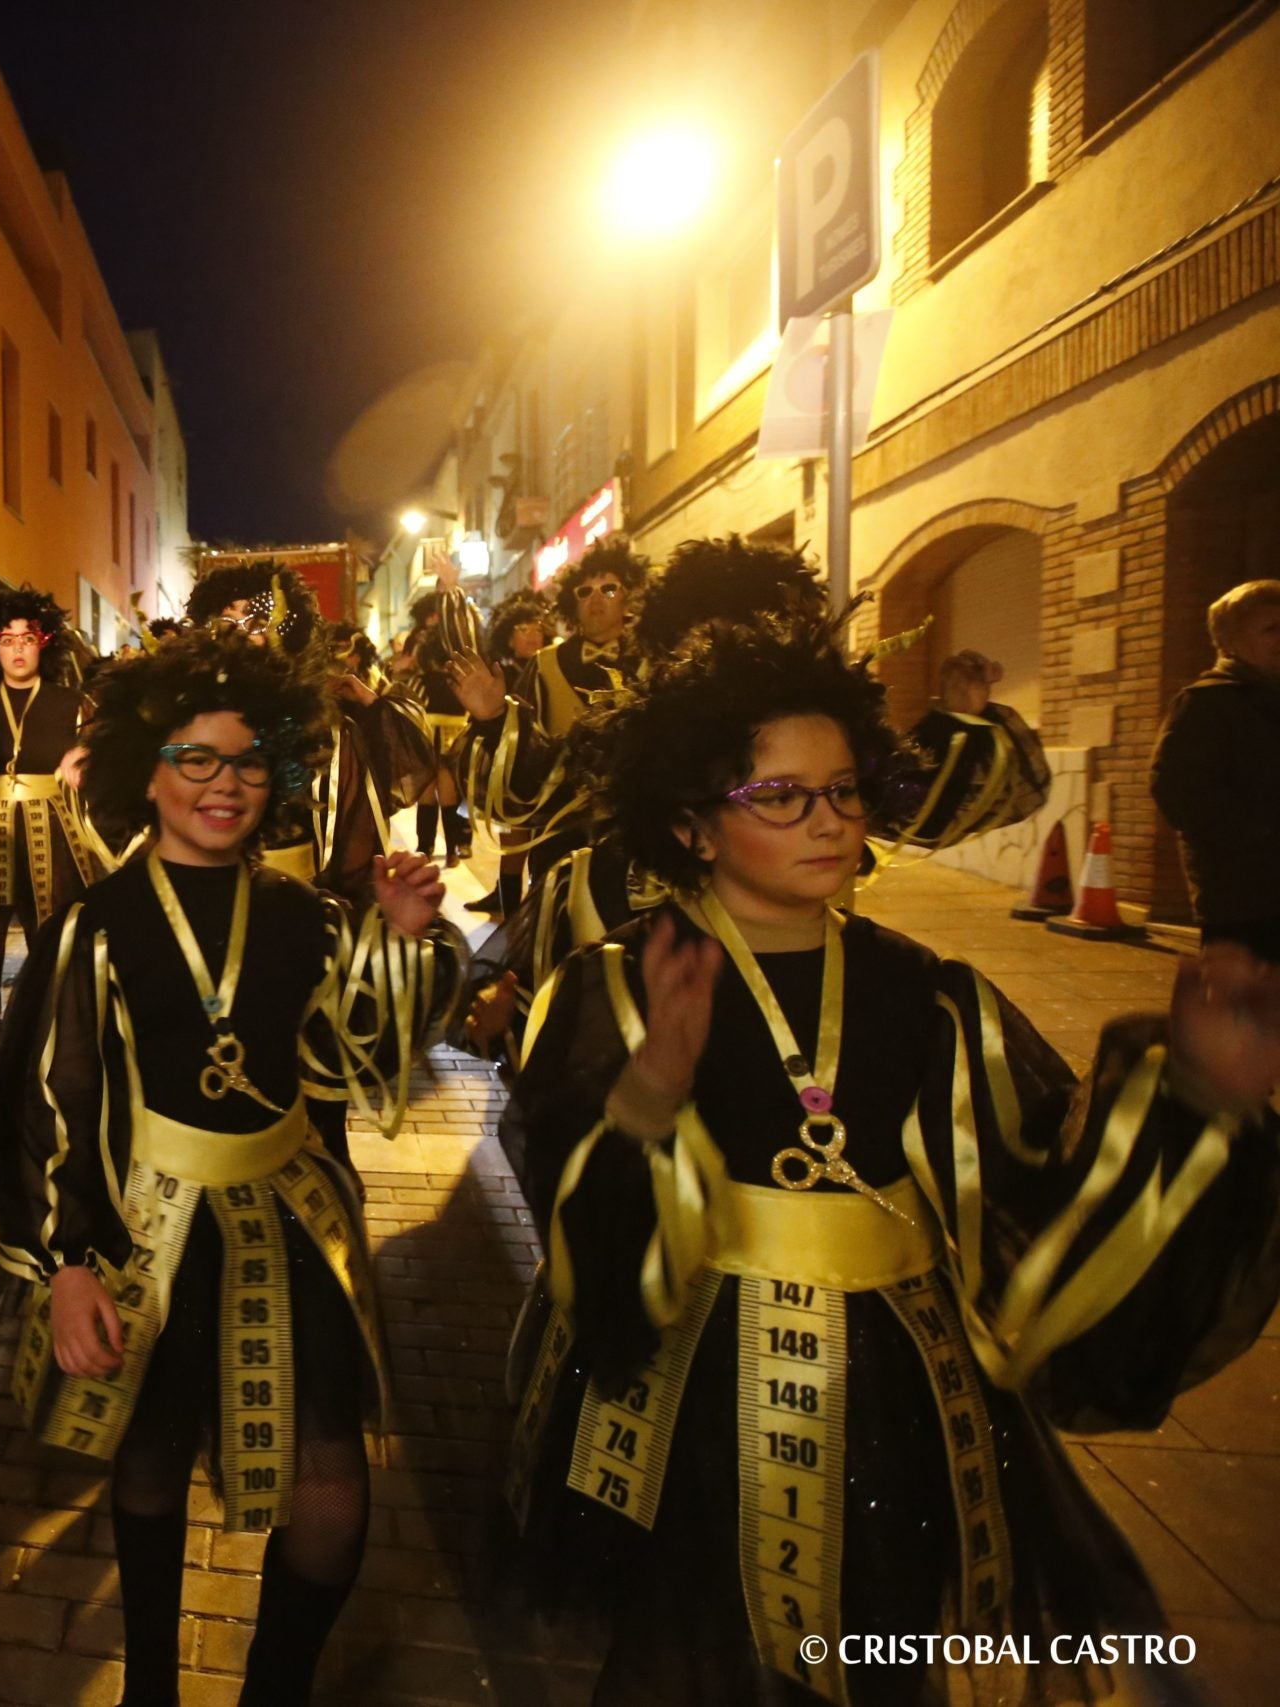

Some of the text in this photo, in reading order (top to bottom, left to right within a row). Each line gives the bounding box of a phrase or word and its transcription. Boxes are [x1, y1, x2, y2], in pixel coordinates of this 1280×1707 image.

[796, 117, 852, 301] P
[155, 1170, 179, 1200] 70
[227, 1184, 255, 1207] 93
[240, 1220, 265, 1243] 94
[241, 1298, 268, 1323] 96
[241, 1339, 270, 1364] 95
[767, 1327, 818, 1360] 148
[242, 1380, 271, 1406] 98
[622, 1379, 649, 1412] 3
[766, 1379, 818, 1413] 148
[243, 1422, 273, 1448] 99
[606, 1420, 637, 1460] 74
[765, 1431, 818, 1468] 150
[244, 1467, 276, 1490] 100
[596, 1467, 629, 1508] 75
[784, 1486, 797, 1518] 1
[244, 1508, 272, 1529] 101
[780, 1540, 799, 1575] 2
[782, 1594, 803, 1630] 3
